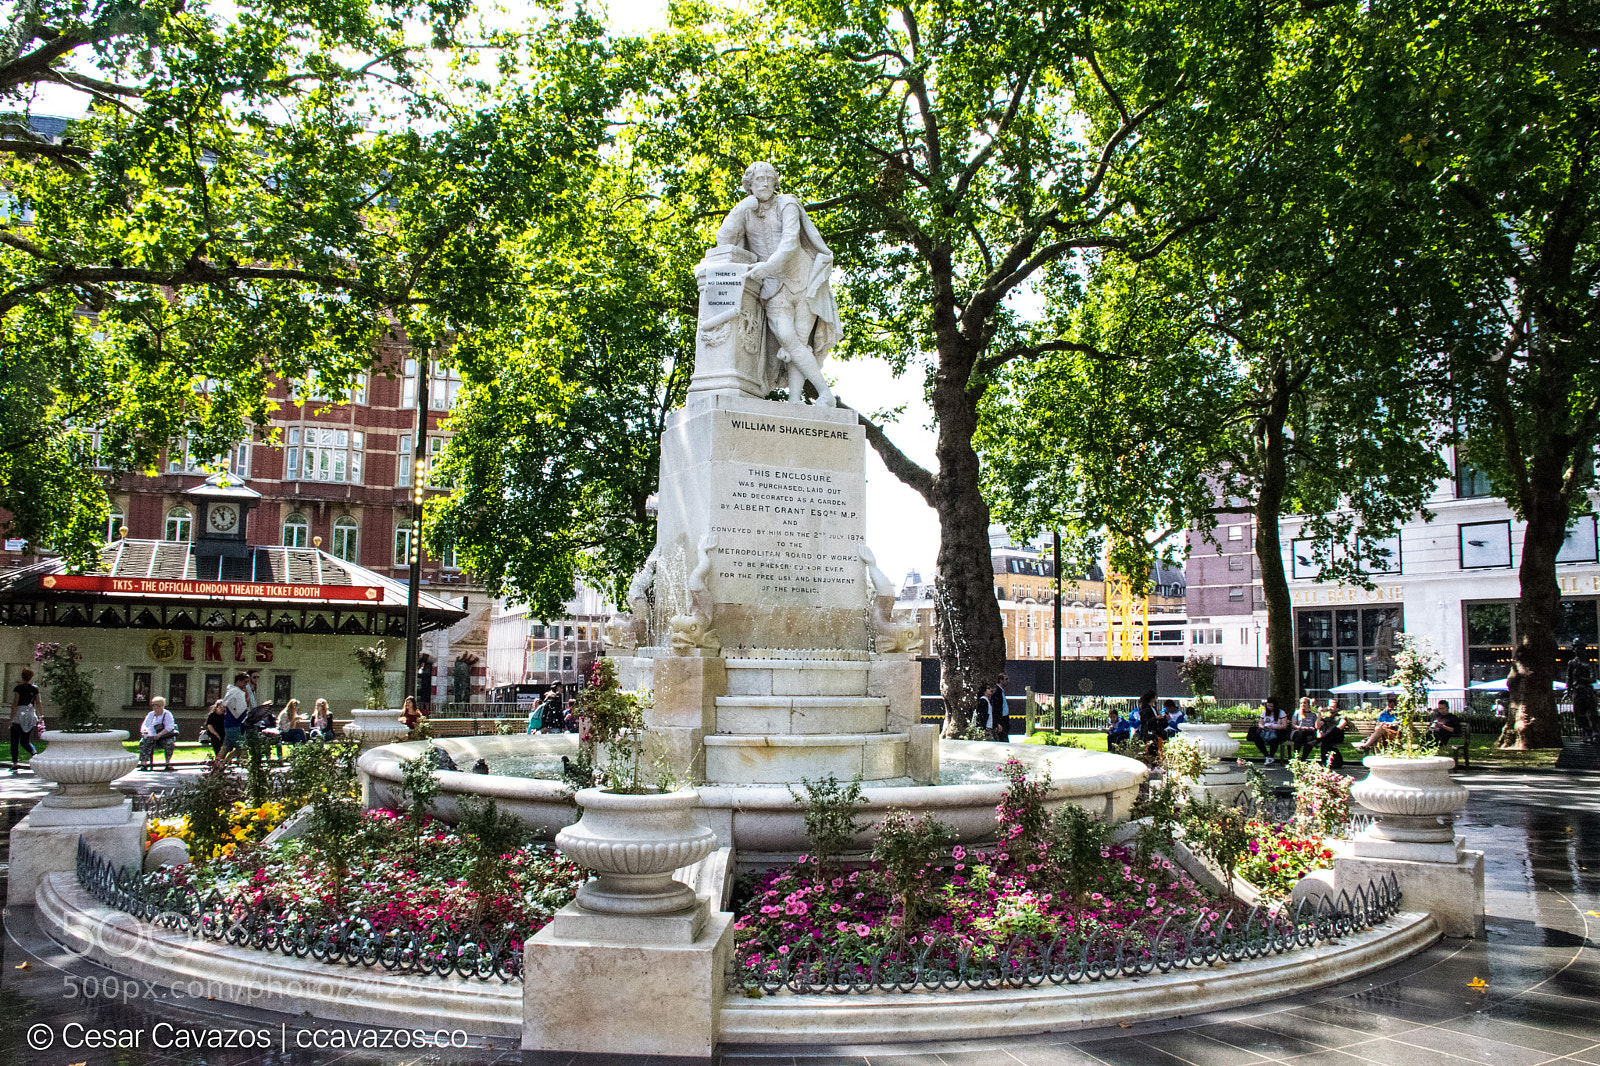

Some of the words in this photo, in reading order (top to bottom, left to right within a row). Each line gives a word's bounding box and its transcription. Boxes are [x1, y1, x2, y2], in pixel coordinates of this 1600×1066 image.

[731, 420, 776, 433] WILLIAM
[780, 426, 849, 440] SHAKESPEARE
[749, 469, 770, 478] THIS
[776, 472, 832, 483] ENCLOSURE
[759, 483, 805, 492] PURCHASED,
[751, 494, 794, 502] DECORATED
[734, 504, 770, 513] ALBERT
[775, 507, 806, 515] GRANT
[841, 511, 858, 520] M.P.
[712, 526, 752, 534] CONVEYED
[718, 547, 781, 558] METROPOLITAN
[785, 552, 812, 560] BOARD
[112, 580, 133, 591] TKTS
[141, 581, 157, 592] THE
[158, 581, 194, 593] OFFICIAL
[196, 583, 229, 594] LONDON
[230, 584, 265, 596] THEATRE
[266, 586, 292, 597] TICKET
[294, 587, 320, 598] BOOTH
[1293, 590, 1320, 605] ALL
[1327, 588, 1359, 604] BAR
[1366, 586, 1404, 602] ONE
[182, 634, 274, 662] tkts
